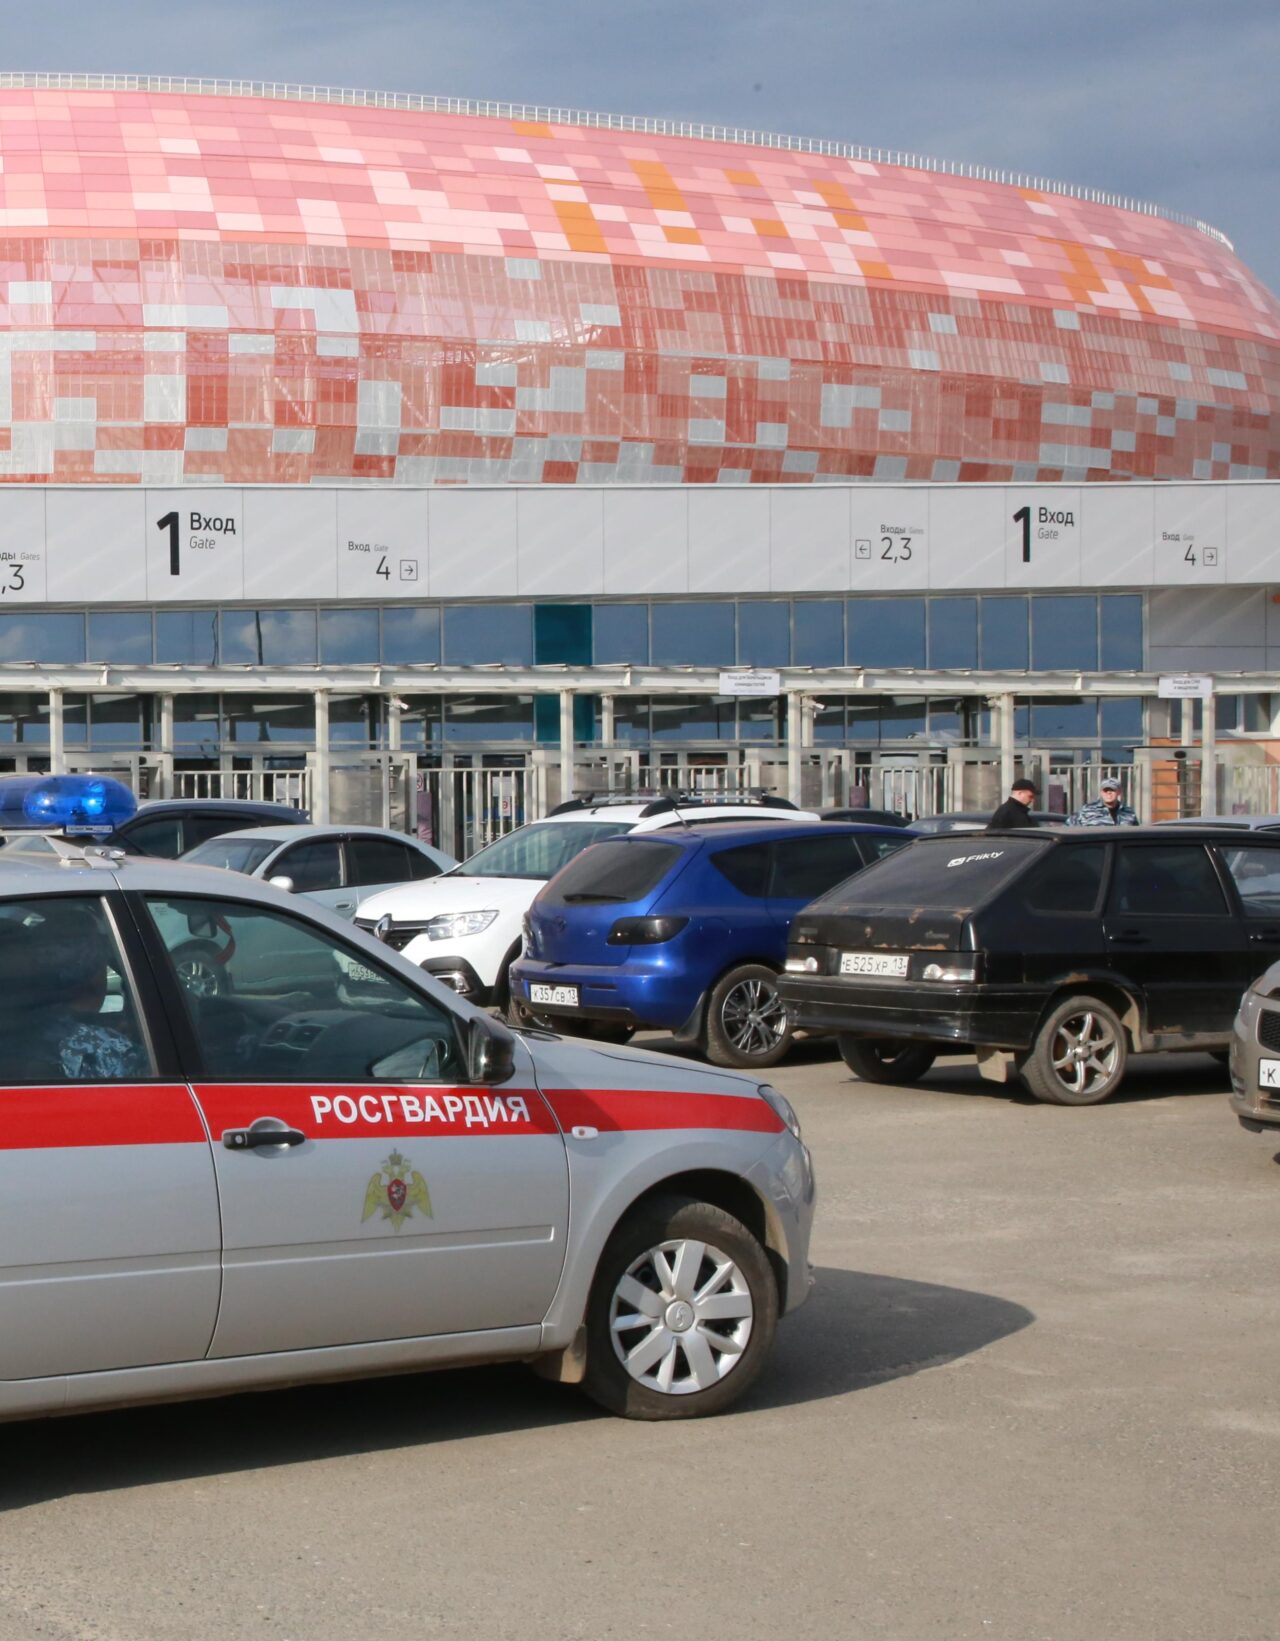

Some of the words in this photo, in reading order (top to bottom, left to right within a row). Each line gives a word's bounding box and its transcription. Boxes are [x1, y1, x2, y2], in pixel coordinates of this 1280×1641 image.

[190, 512, 236, 535] Вход
[1039, 506, 1074, 527] Вход
[880, 524, 906, 535] Входы
[1013, 506, 1030, 563] 1
[1038, 527, 1059, 540] Gate
[156, 511, 180, 576] 1
[189, 535, 216, 549] Gate
[348, 541, 370, 552] Вход
[881, 536, 912, 564] 2,3
[1184, 543, 1197, 566] 4
[376, 555, 391, 581] 4
[310, 1095, 531, 1128] РОСГВАРДИЯ
